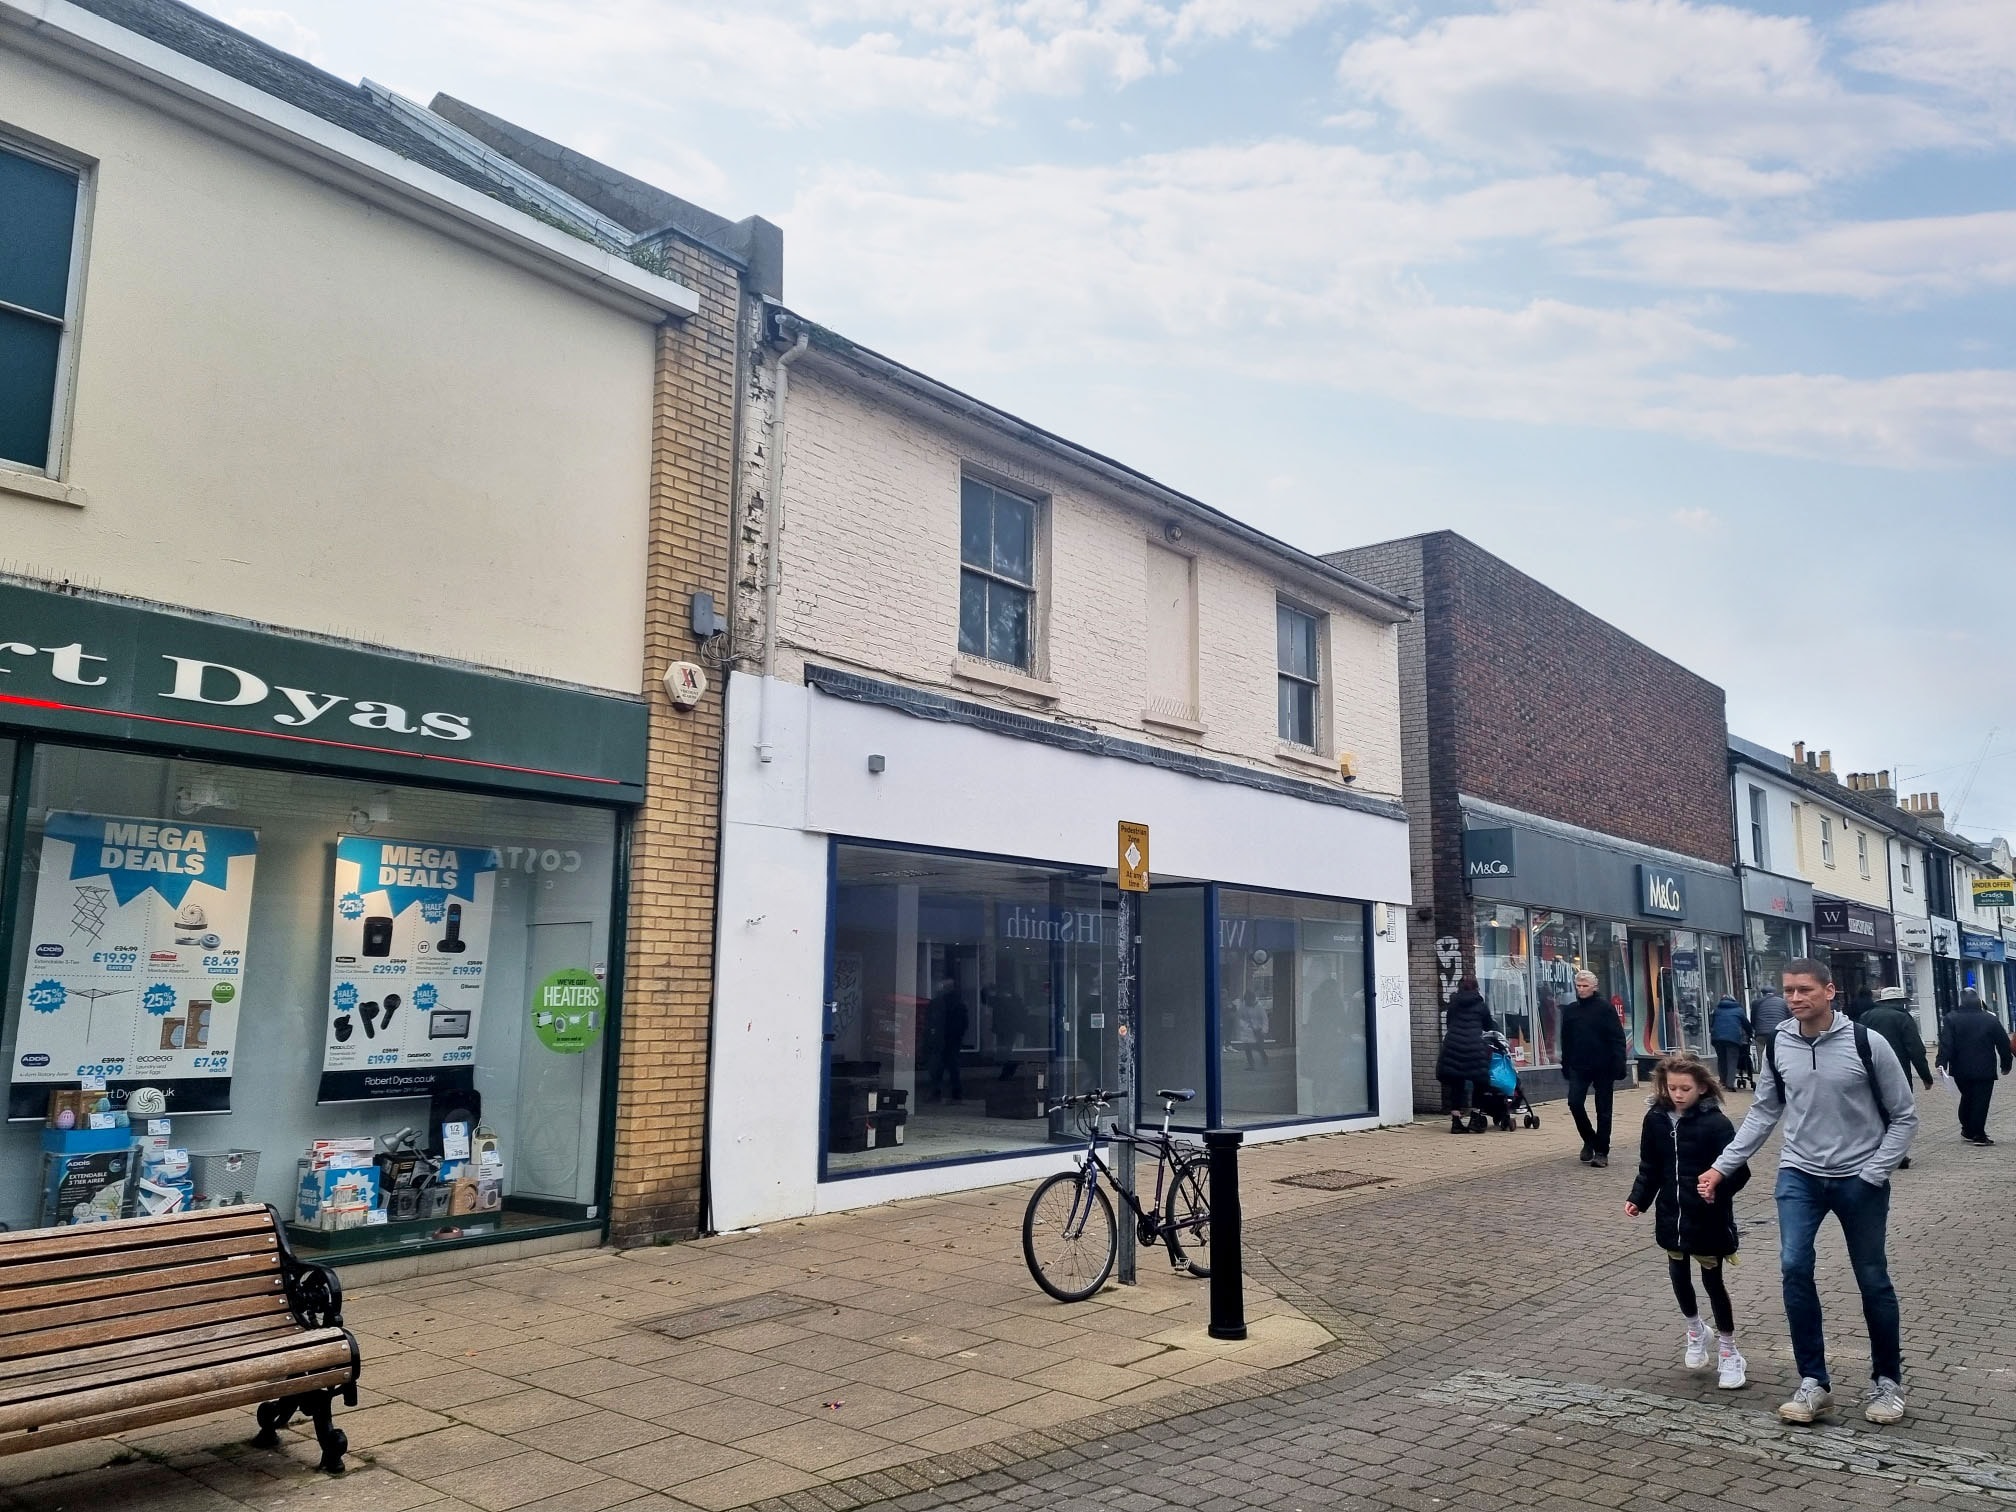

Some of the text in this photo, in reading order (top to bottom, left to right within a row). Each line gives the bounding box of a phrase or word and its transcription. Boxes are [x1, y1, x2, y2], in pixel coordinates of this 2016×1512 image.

[158, 654, 472, 741] Dyas
[1120, 825, 1147, 836] Pedestrian
[104, 822, 206, 852] MEGA
[1127, 835, 1140, 843] Zone
[100, 847, 205, 876] DEALS
[381, 845, 458, 869] MEGA
[378, 867, 457, 889] DEALS
[1128, 879, 1140, 888] time
[1823, 911, 1841, 923] W
[93, 952, 137, 963] £19.99
[203, 956, 239, 966] £8.49
[373, 965, 406, 974] £29.99
[453, 966, 482, 976] £19.99
[1541, 959, 1553, 982] THE
[1553, 961, 1565, 982] JOY
[337, 989, 355, 998] HALF
[417, 989, 434, 997] HALF
[543, 986, 599, 1007] HEATERS
[194, 1057, 227, 1068] £7.49
[367, 1054, 398, 1065] £19.99
[443, 1052, 472, 1062] £39.99
[77, 1064, 124, 1076] £29.99
[69, 1172, 107, 1180] EXTENDABLE
